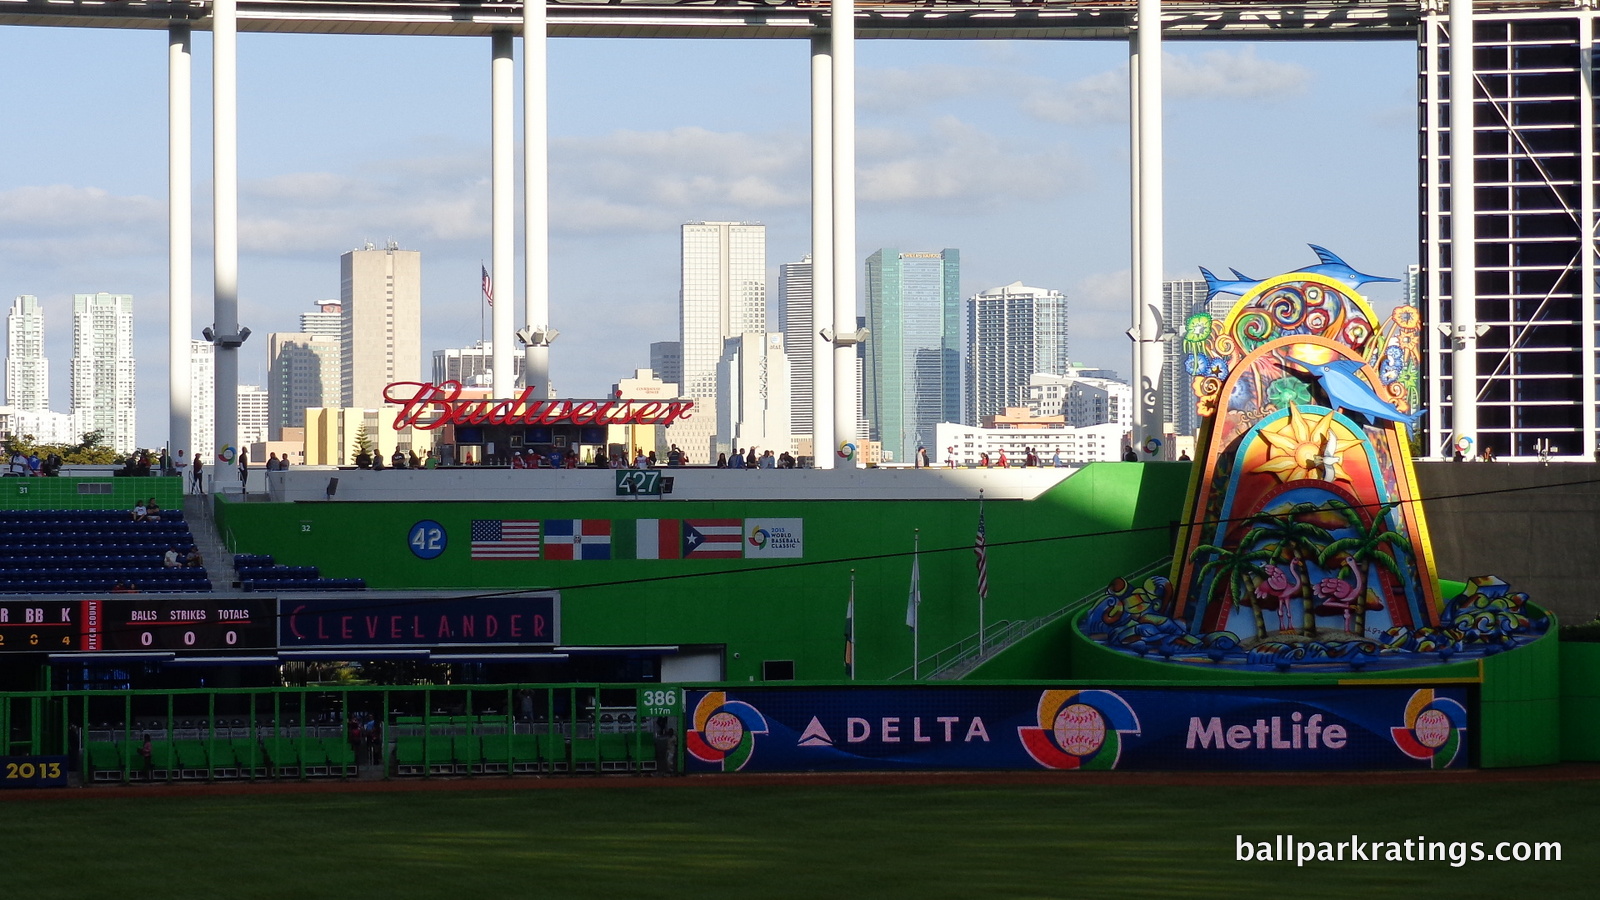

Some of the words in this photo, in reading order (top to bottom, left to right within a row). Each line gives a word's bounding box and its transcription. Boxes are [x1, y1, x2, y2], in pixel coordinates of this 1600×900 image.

[383, 379, 694, 430] Budweiser
[618, 471, 660, 493] 427
[412, 528, 442, 550] 42
[25, 608, 44, 623] BB
[61, 608, 71, 622] K
[88, 601, 97, 626] COUNT
[131, 610, 157, 621] BALLS
[170, 610, 206, 620] STRIKES
[218, 609, 249, 620] TOTALS
[290, 605, 545, 639] CLEVELANDER
[30, 634, 39, 645] 0
[62, 636, 71, 645] 4
[88, 627, 97, 650] PITCH
[141, 632, 153, 646] 0
[184, 632, 196, 646] 0
[226, 630, 237, 645] 0
[643, 690, 676, 706] 386
[649, 707, 671, 715] 117m
[847, 716, 990, 742] DELTA
[1186, 711, 1347, 749] MetLife
[6, 762, 61, 779] 2013
